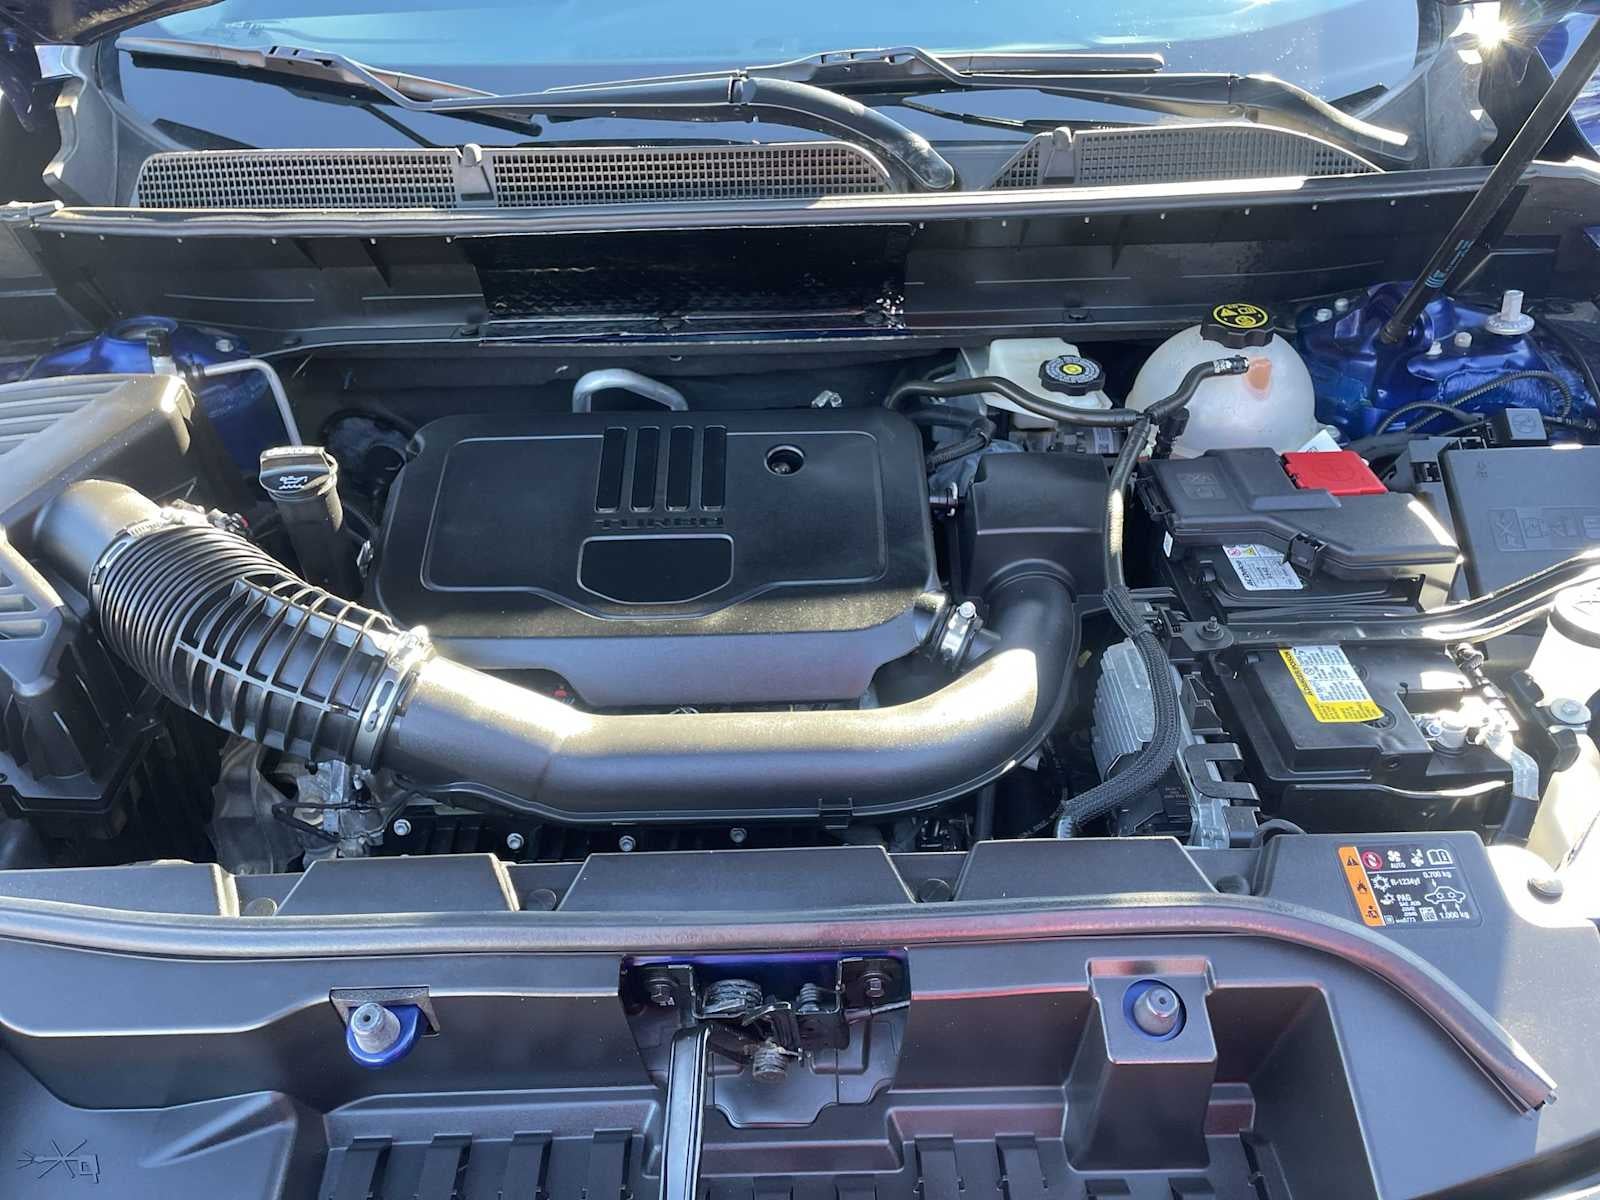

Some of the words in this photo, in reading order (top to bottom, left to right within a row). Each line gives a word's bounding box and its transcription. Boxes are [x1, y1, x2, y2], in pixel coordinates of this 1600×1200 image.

[1422, 871, 1441, 879] 0.700
[1442, 871, 1452, 879] kg
[1396, 893, 1412, 902] PAG
[1439, 911, 1459, 919] 1.000
[1459, 911, 1470, 919] kg
